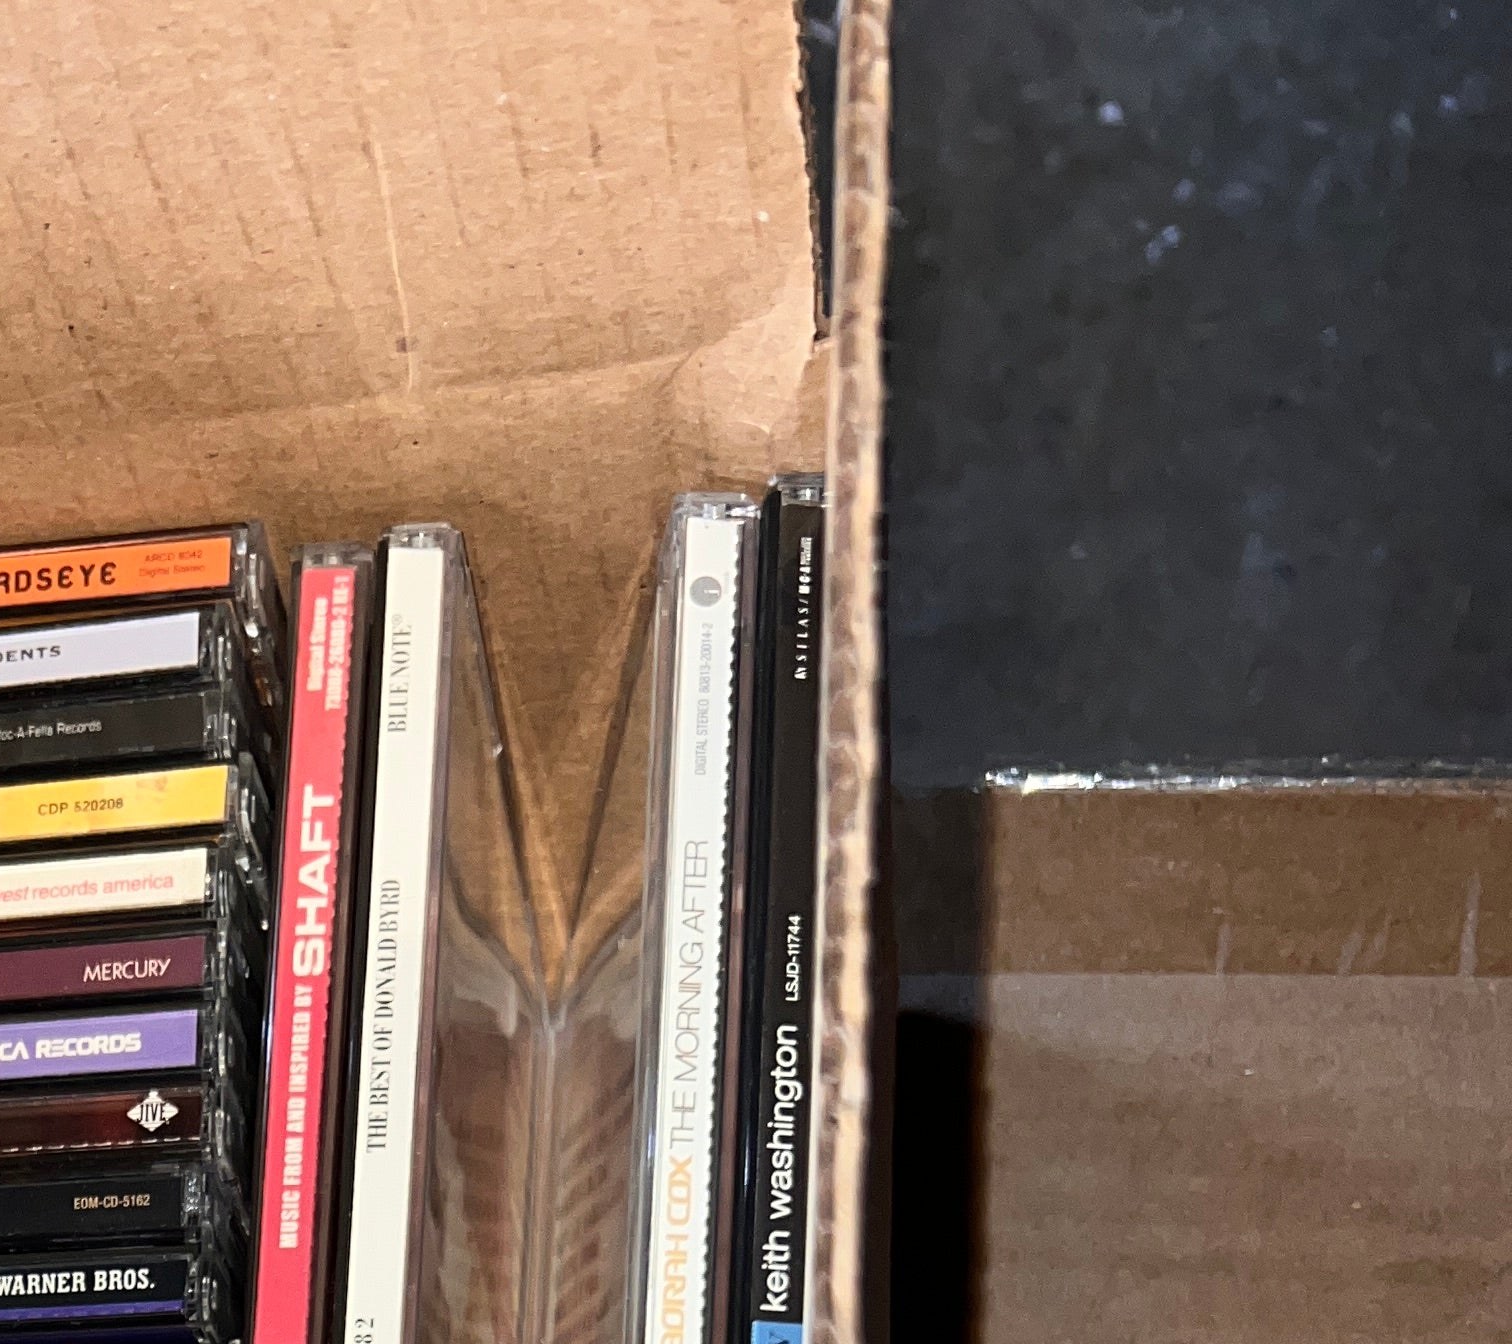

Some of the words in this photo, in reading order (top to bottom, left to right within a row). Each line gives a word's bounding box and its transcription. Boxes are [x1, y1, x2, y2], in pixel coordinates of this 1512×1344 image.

[38, 802, 68, 815] CDP
[292, 784, 336, 978] SHAFT
[379, 879, 400, 933] BYRD
[83, 958, 171, 982] MERCURY
[374, 936, 399, 1016] DONALD
[373, 1023, 394, 1051] OF
[368, 1054, 391, 1107] BEST
[139, 1102, 166, 1122] JIVE
[366, 1109, 388, 1153] THE
[770, 1025, 802, 1223] washington
[73, 1194, 150, 1210] EOM-CD-5162
[93, 1268, 155, 1292] BROS.
[760, 1229, 790, 1312] keith
